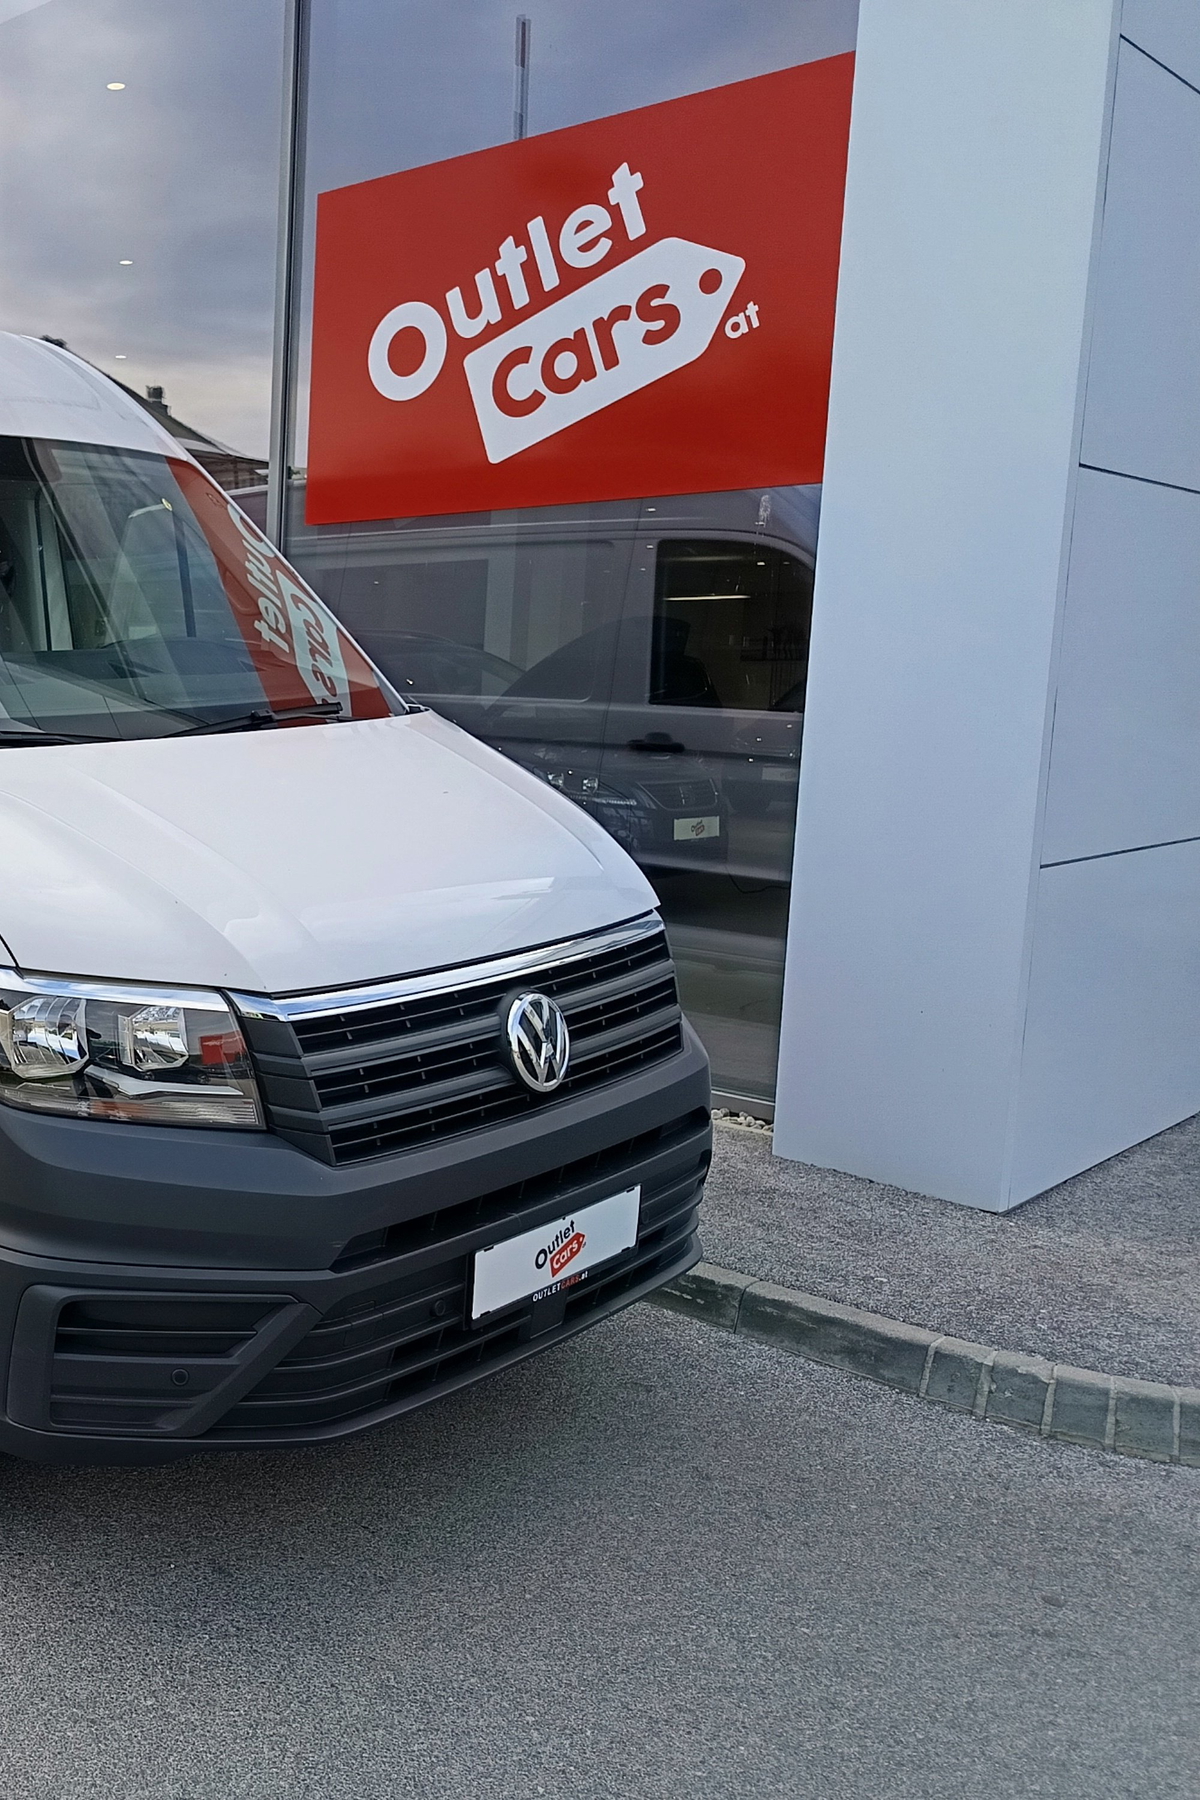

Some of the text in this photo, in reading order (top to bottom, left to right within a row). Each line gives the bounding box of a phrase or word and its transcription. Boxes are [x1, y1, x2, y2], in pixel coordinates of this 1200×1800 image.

[368, 162, 646, 401] Outlet
[492, 284, 761, 418] Cars at
[535, 1219, 575, 1269] Outlet
[552, 1240, 579, 1269] Cars
